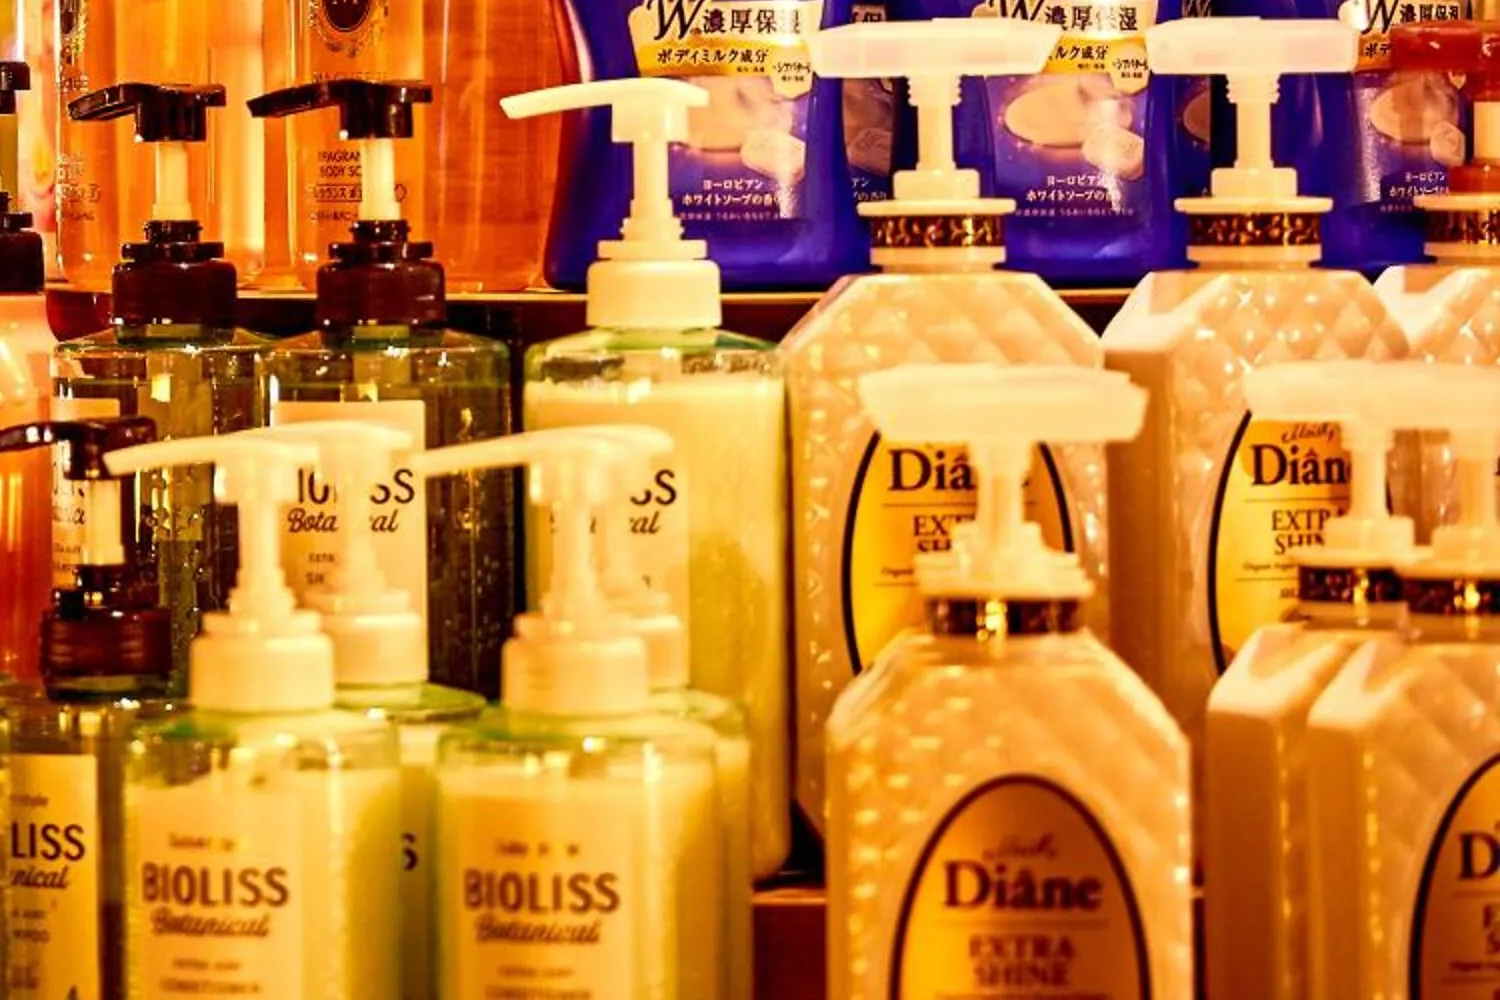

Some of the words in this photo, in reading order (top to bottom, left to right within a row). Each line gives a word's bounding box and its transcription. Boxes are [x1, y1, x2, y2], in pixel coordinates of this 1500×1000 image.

[702, 7, 800, 34] 濃厚保
[657, 49, 770, 64] ボディミルク成分
[888, 448, 977, 491] Diâ
[1251, 444, 1351, 486] Diân
[287, 508, 399, 533] Botaal
[1271, 509, 1332, 531] EXTR
[11, 822, 85, 861] LISS
[142, 862, 290, 907] BIOLISS
[463, 868, 620, 914] BIOLISS
